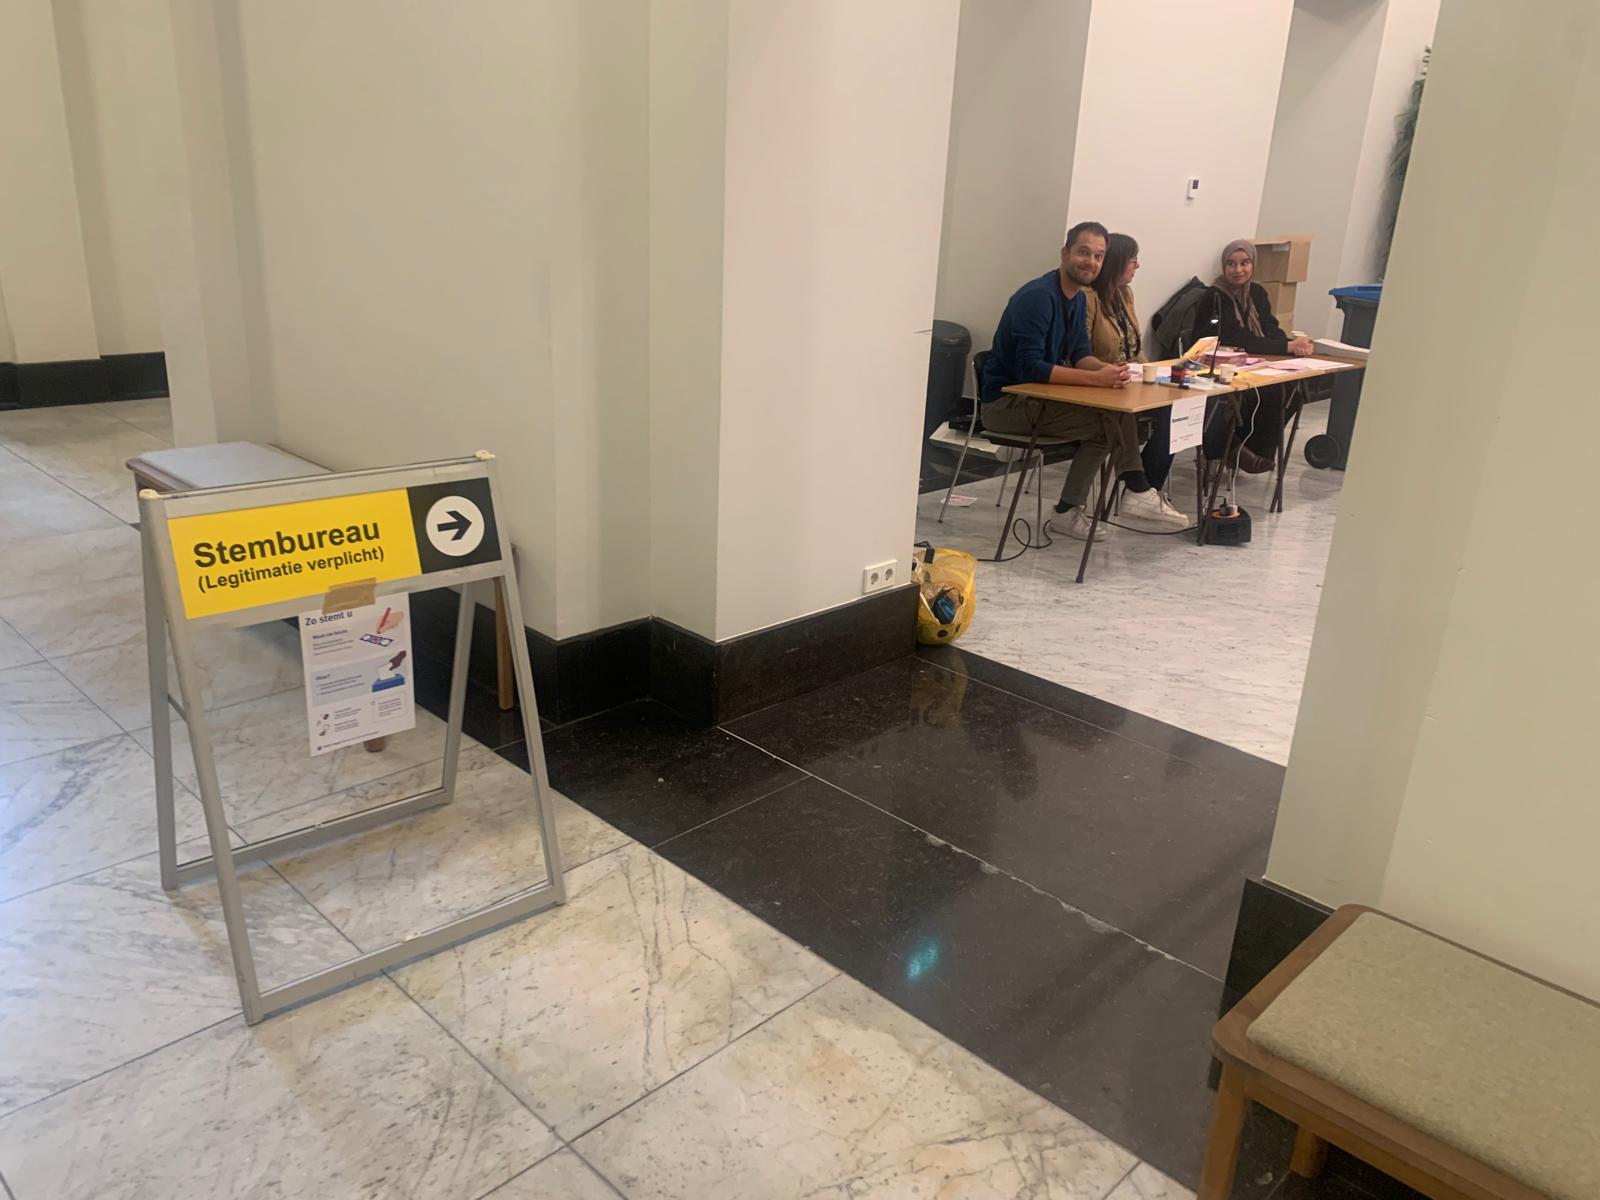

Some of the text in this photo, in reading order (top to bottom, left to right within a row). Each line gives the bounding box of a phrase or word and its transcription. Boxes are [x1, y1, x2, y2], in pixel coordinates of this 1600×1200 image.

[193, 522, 380, 568] Stembureau
[197, 545, 385, 593] (Legitimatie verplicht)
[305, 617, 317, 626] Zo
[319, 611, 345, 624] stemt
